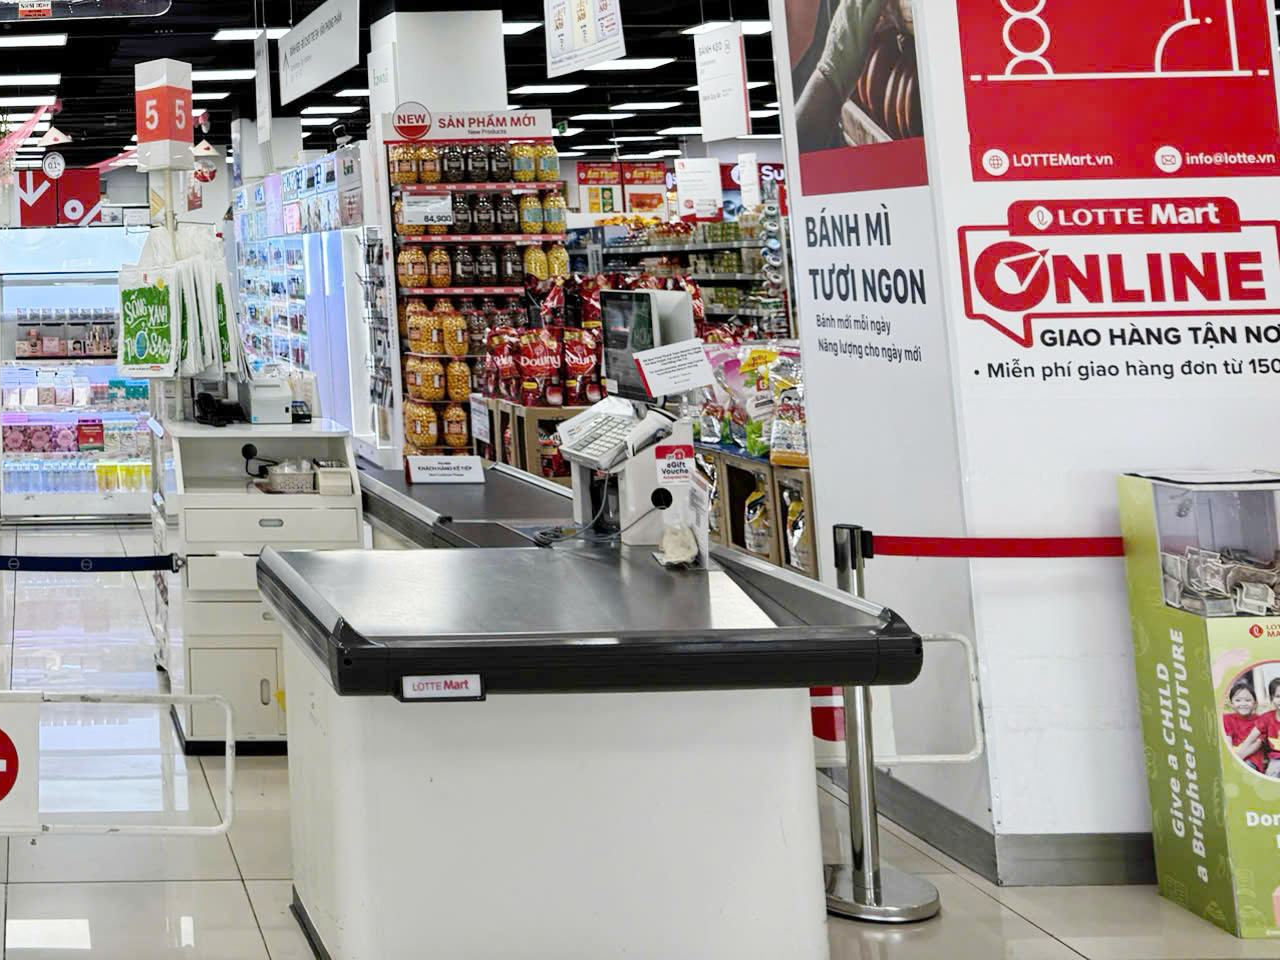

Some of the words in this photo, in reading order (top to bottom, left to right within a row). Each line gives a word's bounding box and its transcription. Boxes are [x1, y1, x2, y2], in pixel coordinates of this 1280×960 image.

[145, 99, 159, 130] 5
[175, 99, 186, 129] 5
[398, 115, 426, 124] NEW
[438, 116, 465, 128] SẢN
[510, 115, 536, 127] MỚI
[1013, 153, 1114, 169] LOTTEMart.vn
[1185, 151, 1276, 166] info@lotte.vn
[424, 215, 452, 223] 84,900
[805, 207, 860, 247] BÁNH
[865, 203, 892, 247] MÌ
[1058, 207, 1144, 226] LOTTE
[1150, 203, 1220, 224] Mart
[809, 263, 857, 303] TƯƠI
[861, 268, 927, 305] NGON
[974, 240, 1267, 312] ONLINE
[816, 313, 836, 328] Bánh
[837, 314, 852, 329] mới
[853, 314, 869, 330] mỗi
[871, 316, 891, 335] ngày
[1040, 328, 1101, 347] GIAO
[1109, 323, 1182, 345] HÀNG
[1188, 322, 1236, 349] TẬN
[520, 355, 561, 368] Downy
[818, 338, 838, 356] Năng
[839, 339, 862, 359] lượng
[864, 342, 880, 357] cho
[881, 343, 902, 363] ngày
[904, 345, 922, 362] mới
[987, 358, 1035, 378] Miễn
[1042, 361, 1071, 381] phí
[1077, 361, 1119, 381] giao
[1126, 360, 1175, 379] hàng
[1180, 359, 1217, 375] đơn
[1223, 359, 1243, 375] từ
[413, 681, 442, 691] LOTTE
[443, 680, 469, 690] Mart
[1170, 628, 1194, 736] FUTURE
[1156, 662, 1178, 748] CHILD
[1168, 754, 1179, 771] a
[1170, 778, 1186, 838] Give
[1185, 744, 1209, 858] Brighter
[1197, 865, 1208, 883] a
